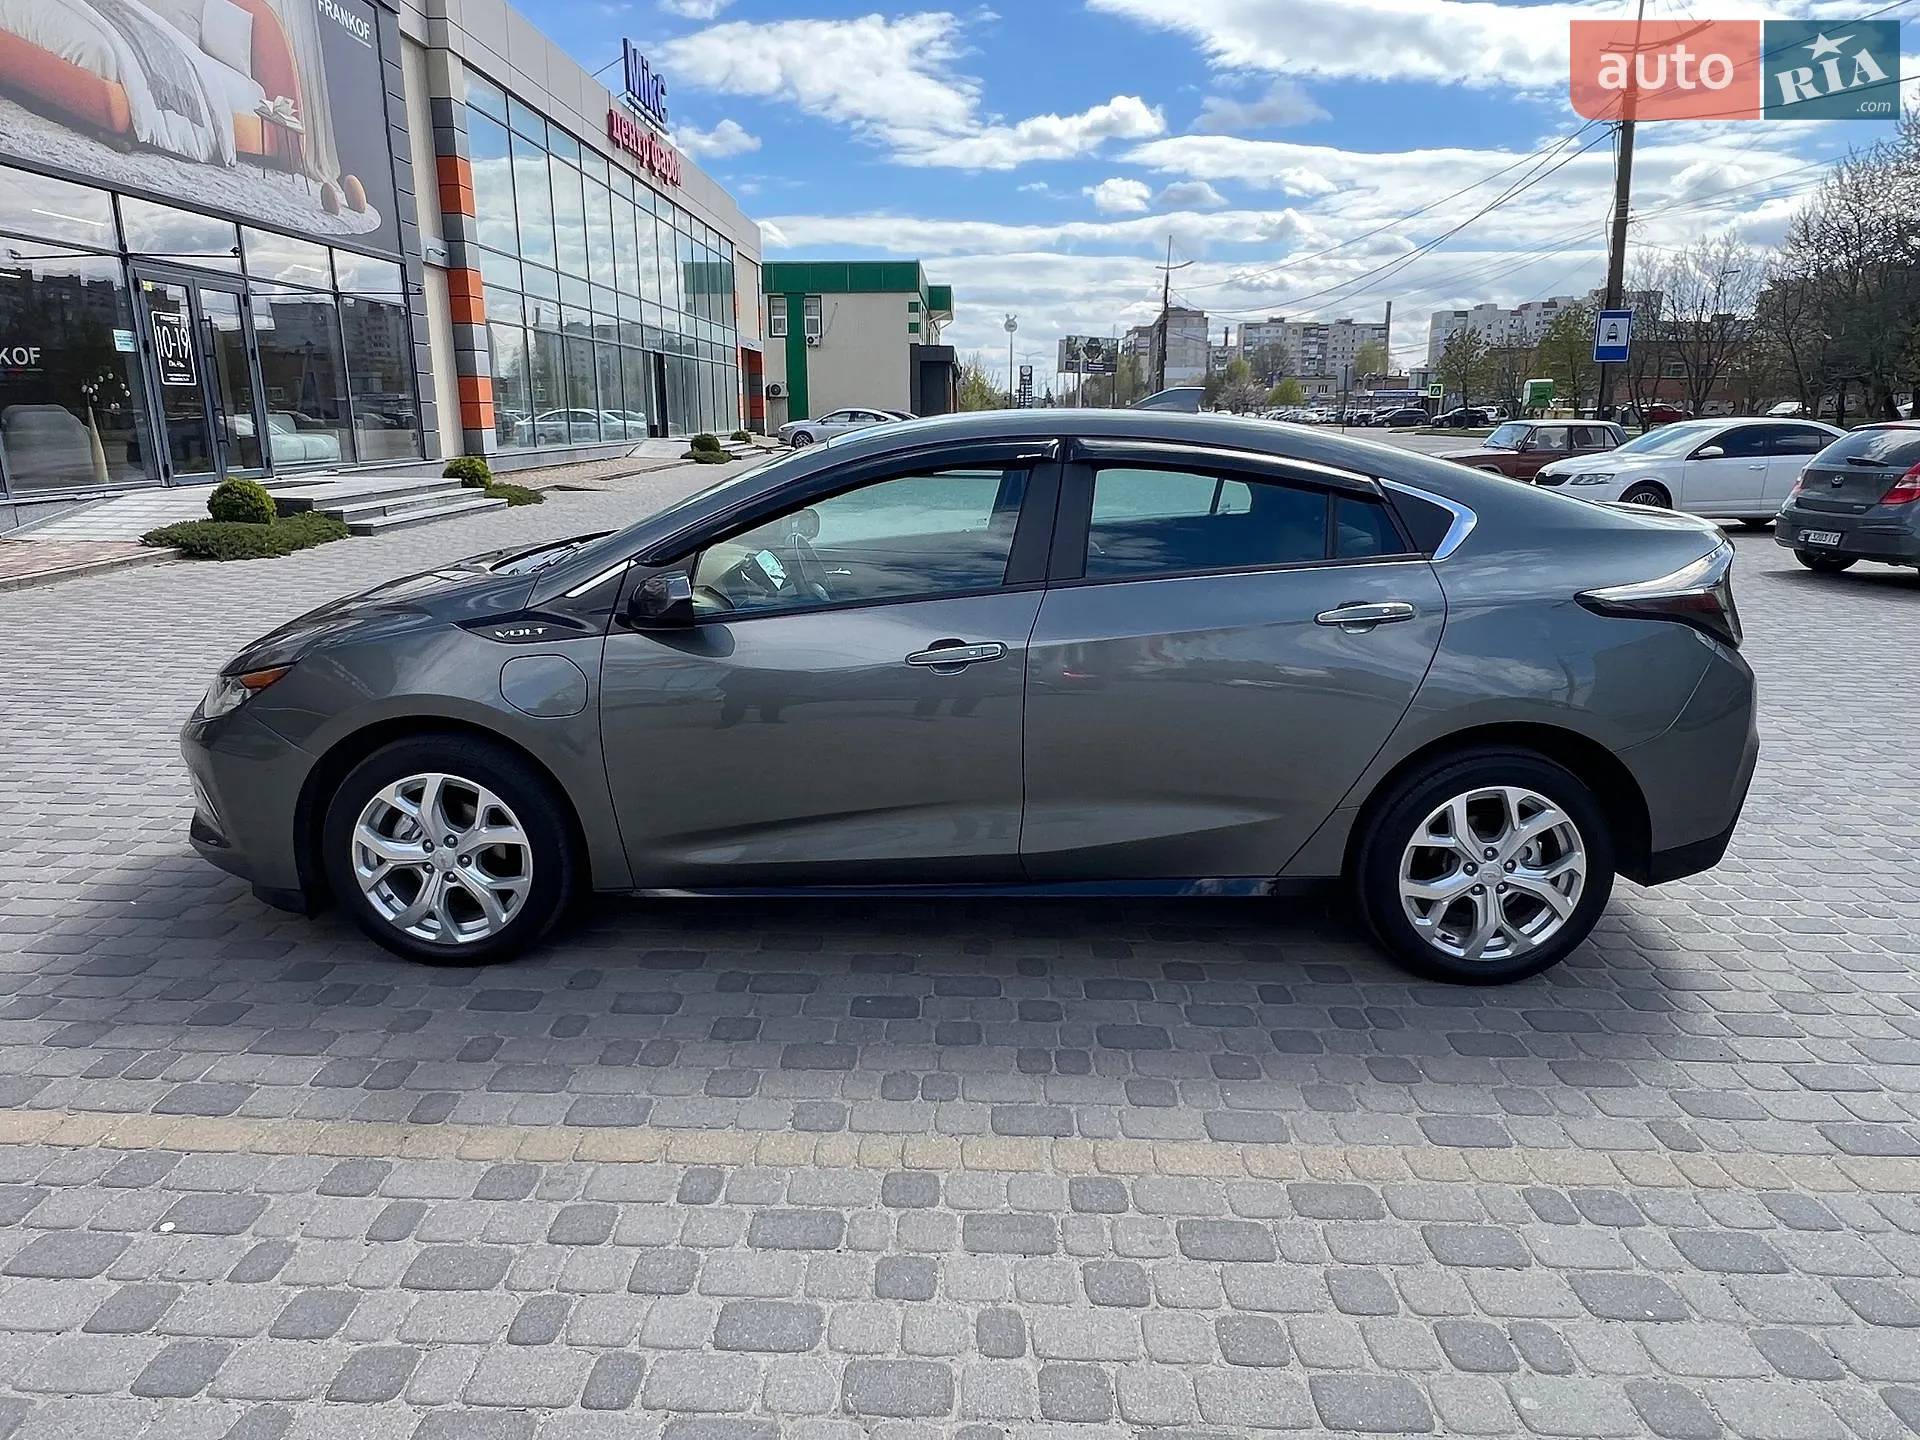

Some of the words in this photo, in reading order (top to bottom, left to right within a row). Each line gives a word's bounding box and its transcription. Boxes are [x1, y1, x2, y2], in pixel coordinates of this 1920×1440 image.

[318, 0, 370, 40] FRANKOF
[156, 325, 189, 359] 10-19
[495, 628, 547, 639] VOLT
